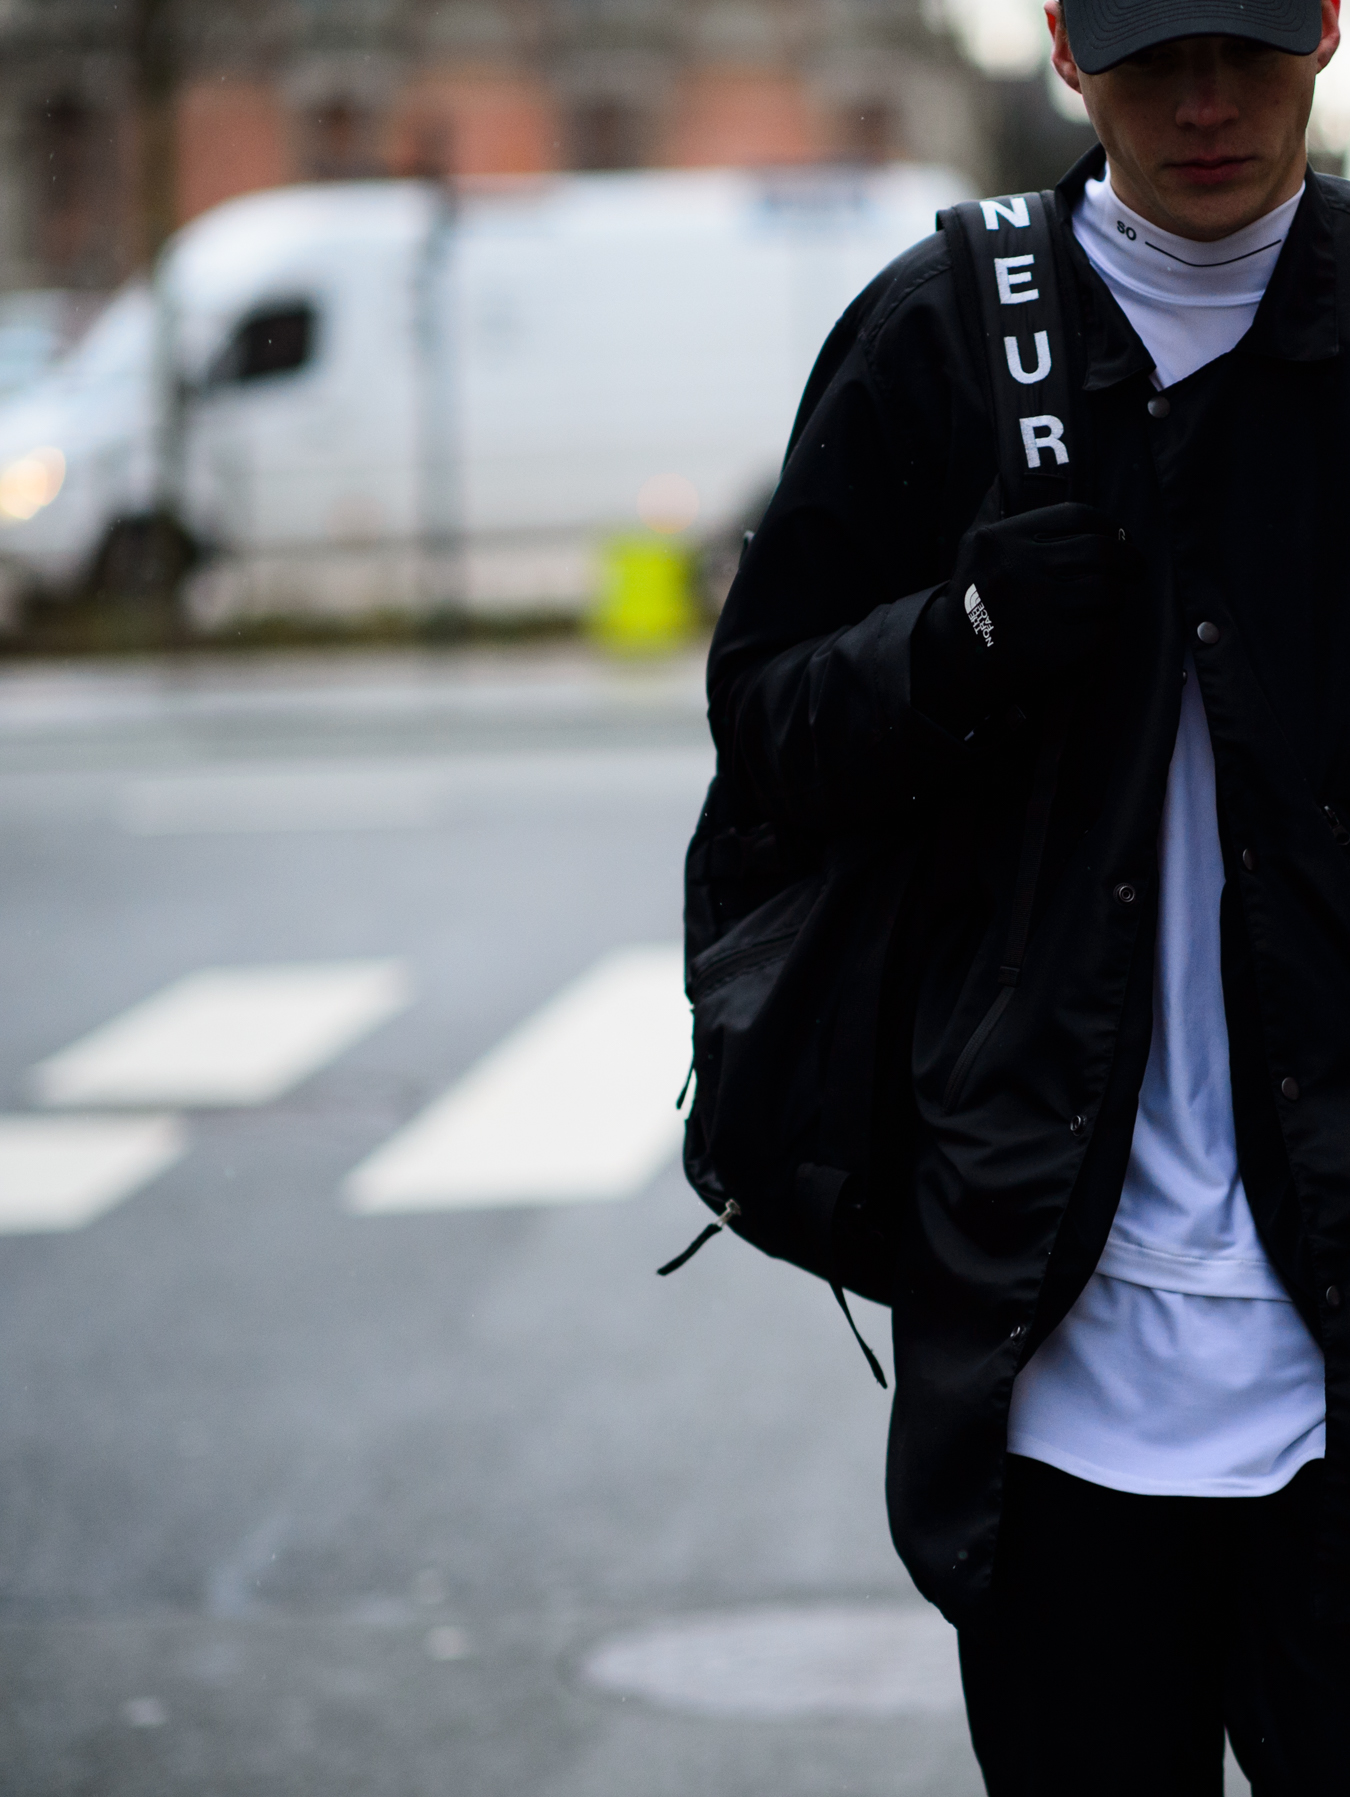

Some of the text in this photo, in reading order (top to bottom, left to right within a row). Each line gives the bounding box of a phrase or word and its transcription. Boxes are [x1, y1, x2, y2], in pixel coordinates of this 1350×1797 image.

[1117, 220, 1137, 241] SO
[972, 605, 994, 647] NORTH
[980, 602, 994, 631] FACE
